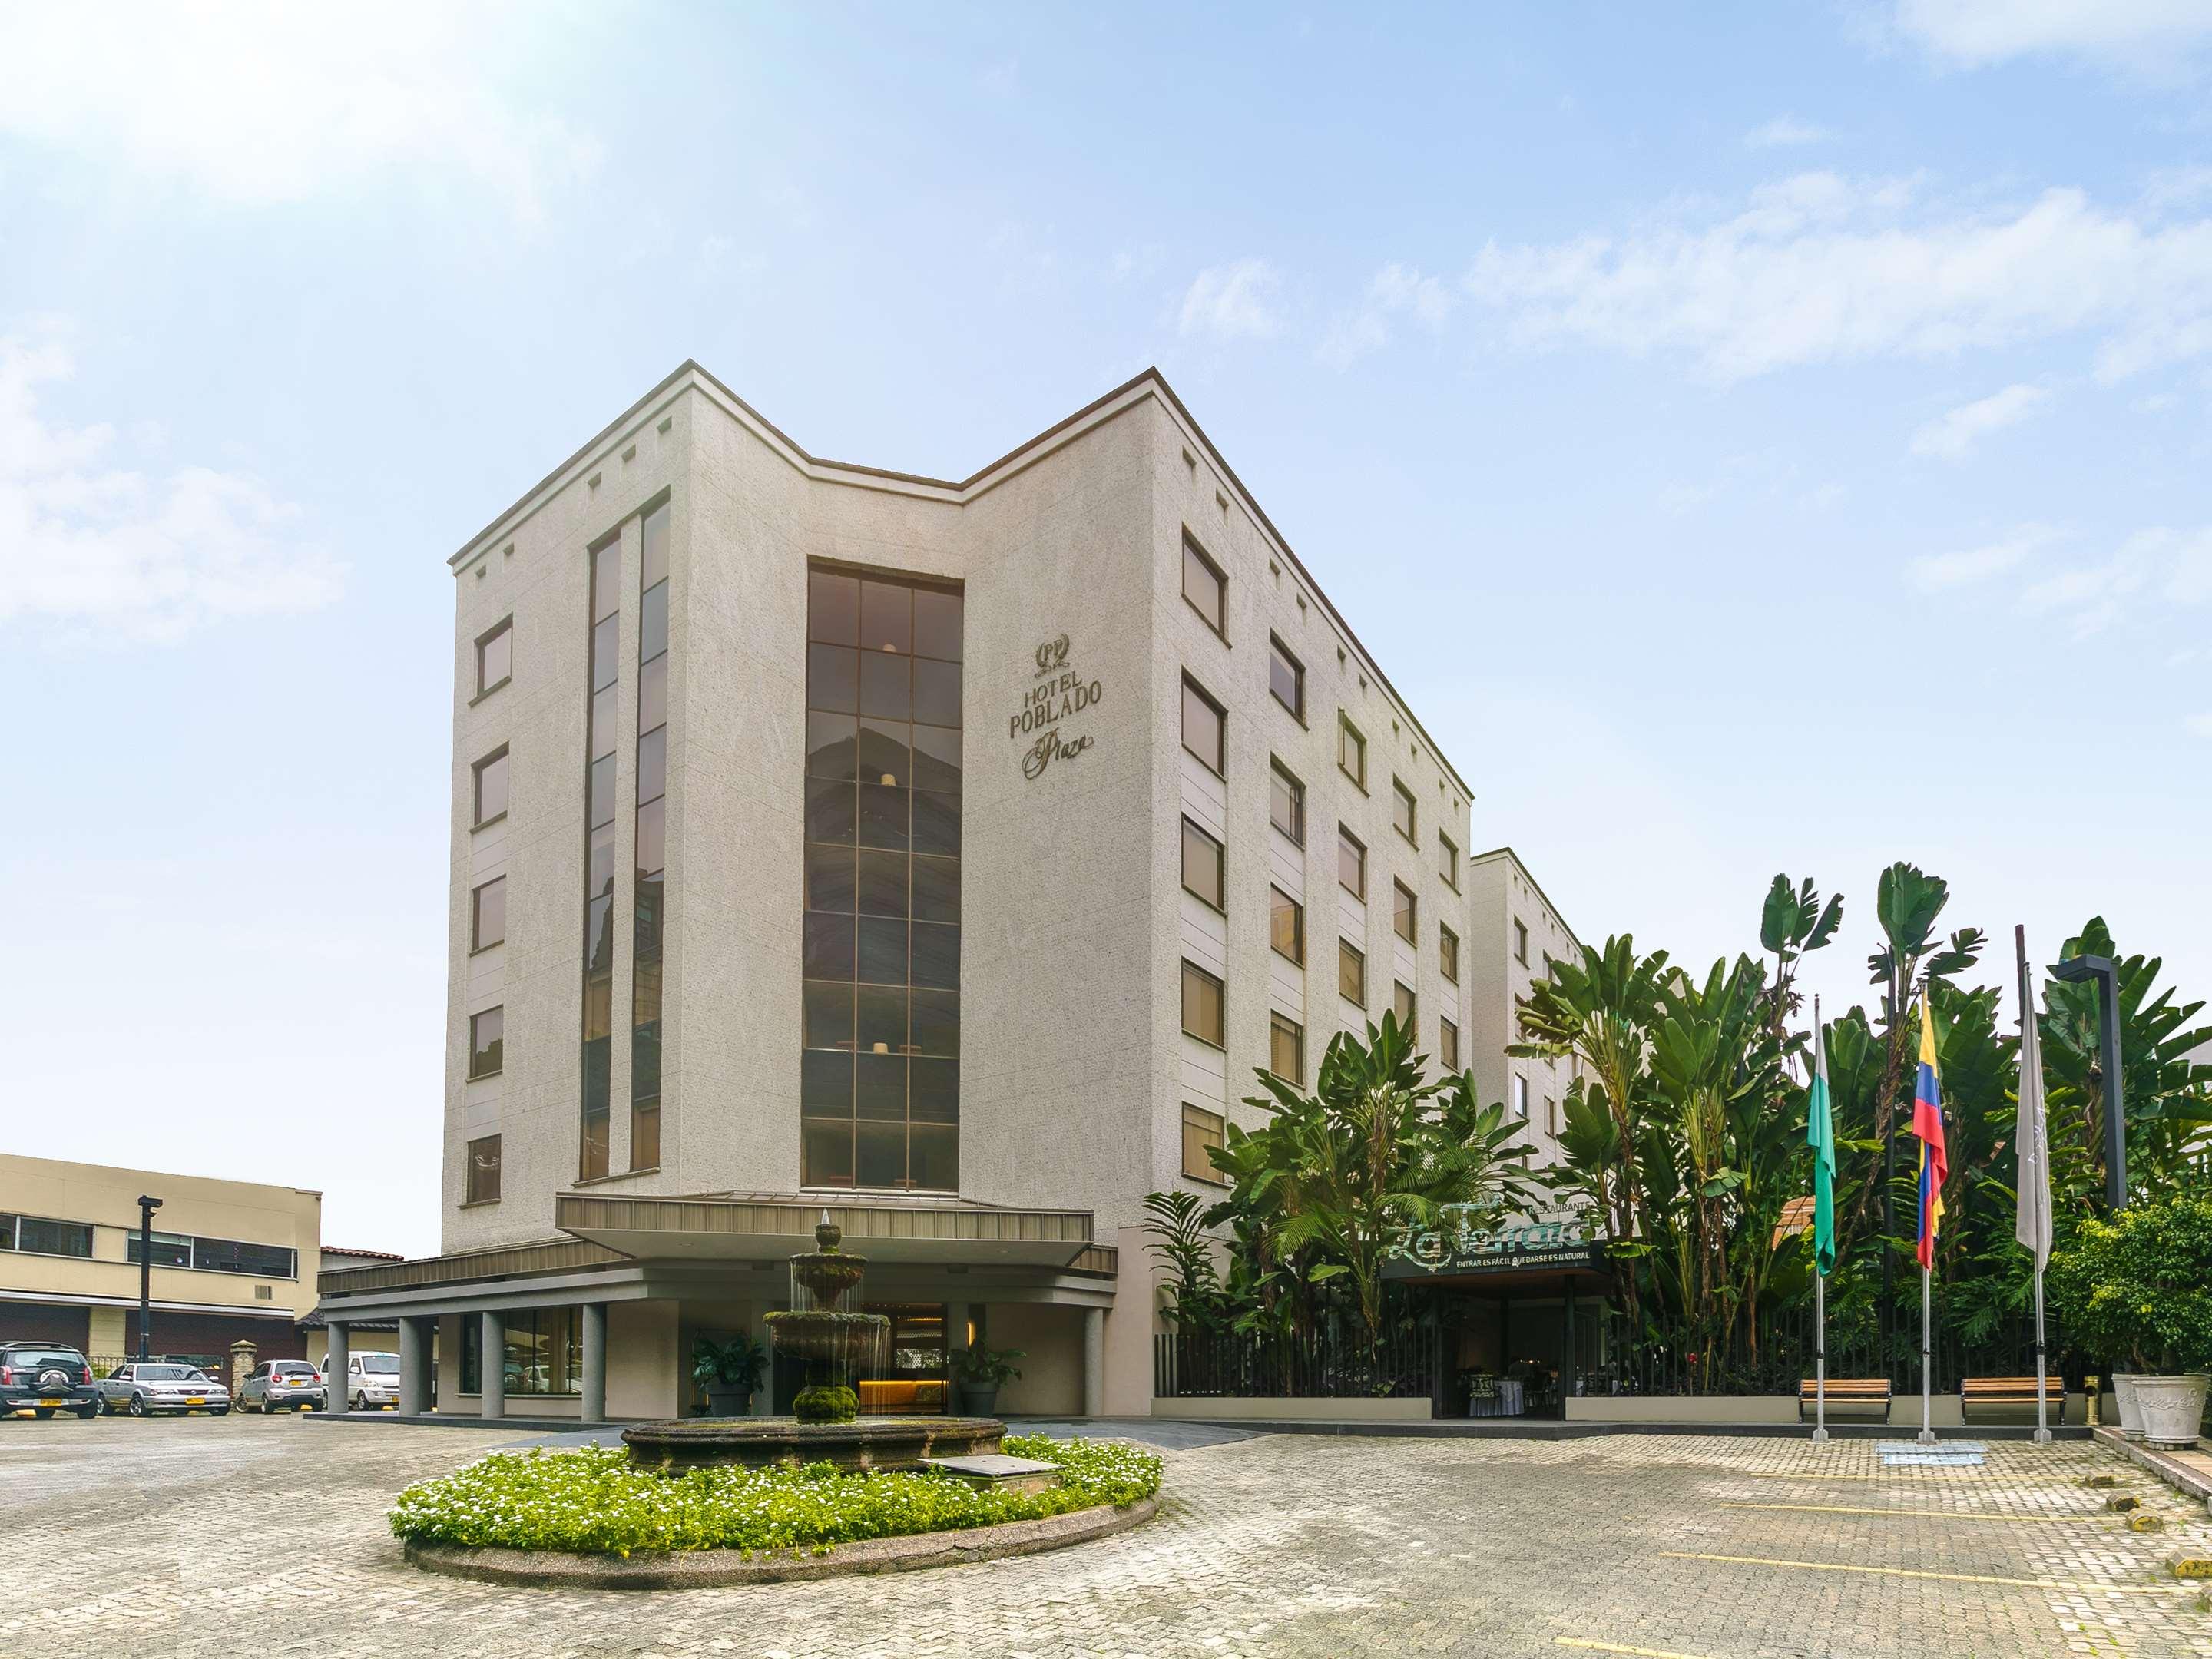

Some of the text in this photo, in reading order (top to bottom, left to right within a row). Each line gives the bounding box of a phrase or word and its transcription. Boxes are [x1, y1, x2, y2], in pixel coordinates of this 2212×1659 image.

[1010, 680, 1101, 739] POBLADO
[1025, 671, 1082, 708] HOTEL
[1022, 727, 1094, 780] Plaza
[1386, 1216, 1452, 1268] La
[1456, 1260, 1482, 1268] ENTRAR
[1482, 1258, 1491, 1267] ES
[1512, 1254, 1548, 1267] QUEDARSE
[1558, 1252, 1590, 1261] NATURAL
